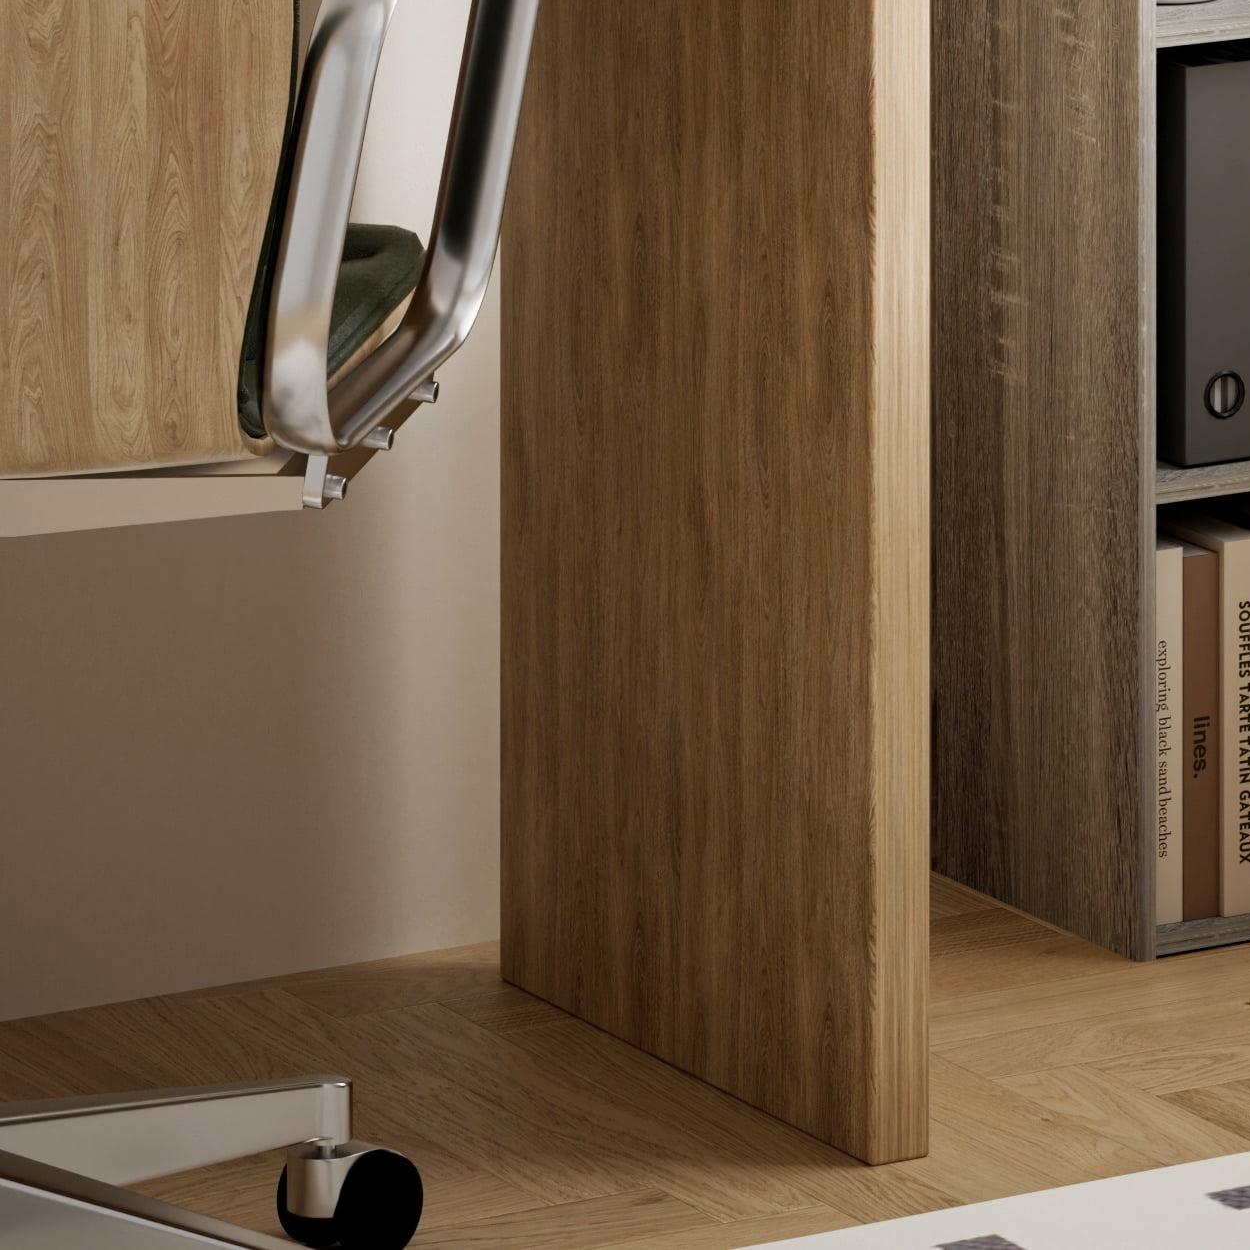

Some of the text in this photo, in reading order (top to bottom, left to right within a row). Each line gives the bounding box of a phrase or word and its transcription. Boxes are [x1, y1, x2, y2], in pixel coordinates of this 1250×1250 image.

[1239, 682, 1250, 733] TARTE
[1156, 640, 1171, 858] exploring black sand beaches
[1193, 715, 1211, 779] lines.
[1239, 735, 1250, 784] TATIN
